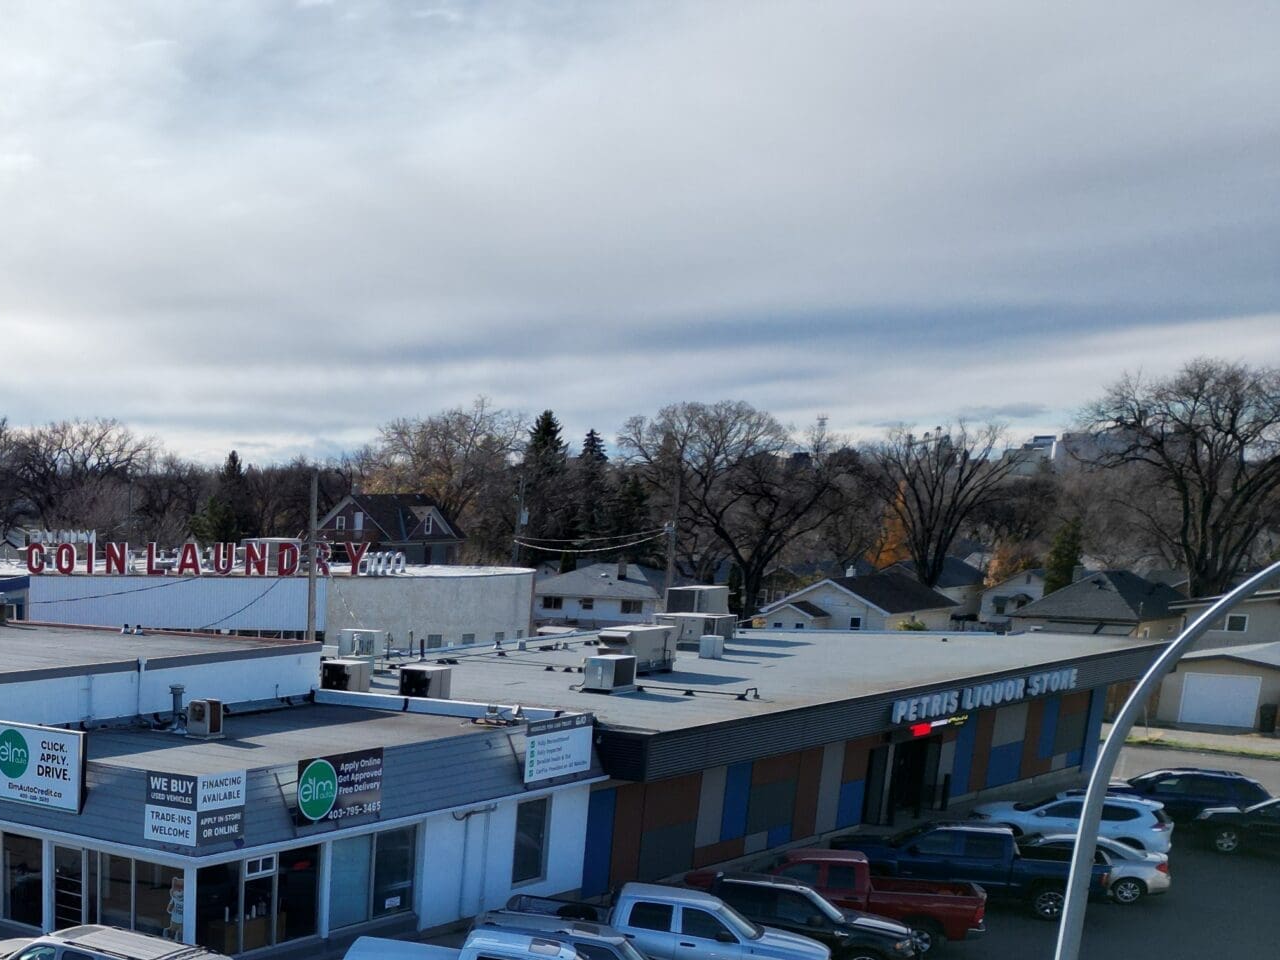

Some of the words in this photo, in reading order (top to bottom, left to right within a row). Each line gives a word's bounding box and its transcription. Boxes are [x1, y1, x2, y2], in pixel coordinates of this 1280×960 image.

[27, 541, 128, 576] COIN
[147, 541, 371, 577] LAUNDRY
[891, 690, 960, 724] PETRIS
[961, 677, 1026, 710] LIQUOR
[1026, 667, 1078, 697] STORE
[40, 740, 68, 753] CLICK.
[40, 753, 69, 766] APPLY.
[340, 761, 360, 773] Apply
[360, 757, 381, 768] Online
[37, 764, 71, 781] DRIVE.
[338, 774, 350, 783] Get
[351, 768, 382, 782] Approved
[150, 776, 168, 791] WE
[170, 779, 194, 794] BUY
[202, 776, 242, 790] FINANCING
[339, 786, 353, 795] Free
[355, 782, 381, 792] Delivery
[150, 792, 165, 800] USED
[166, 793, 192, 804] VEHICLES
[202, 790, 241, 804] AVAILABLE
[150, 811, 192, 825] TRADE-INS
[200, 816, 217, 825] APPLY
[151, 824, 190, 839] WELCOME
[202, 829, 213, 838] OR
[214, 824, 239, 836] ONLINE
